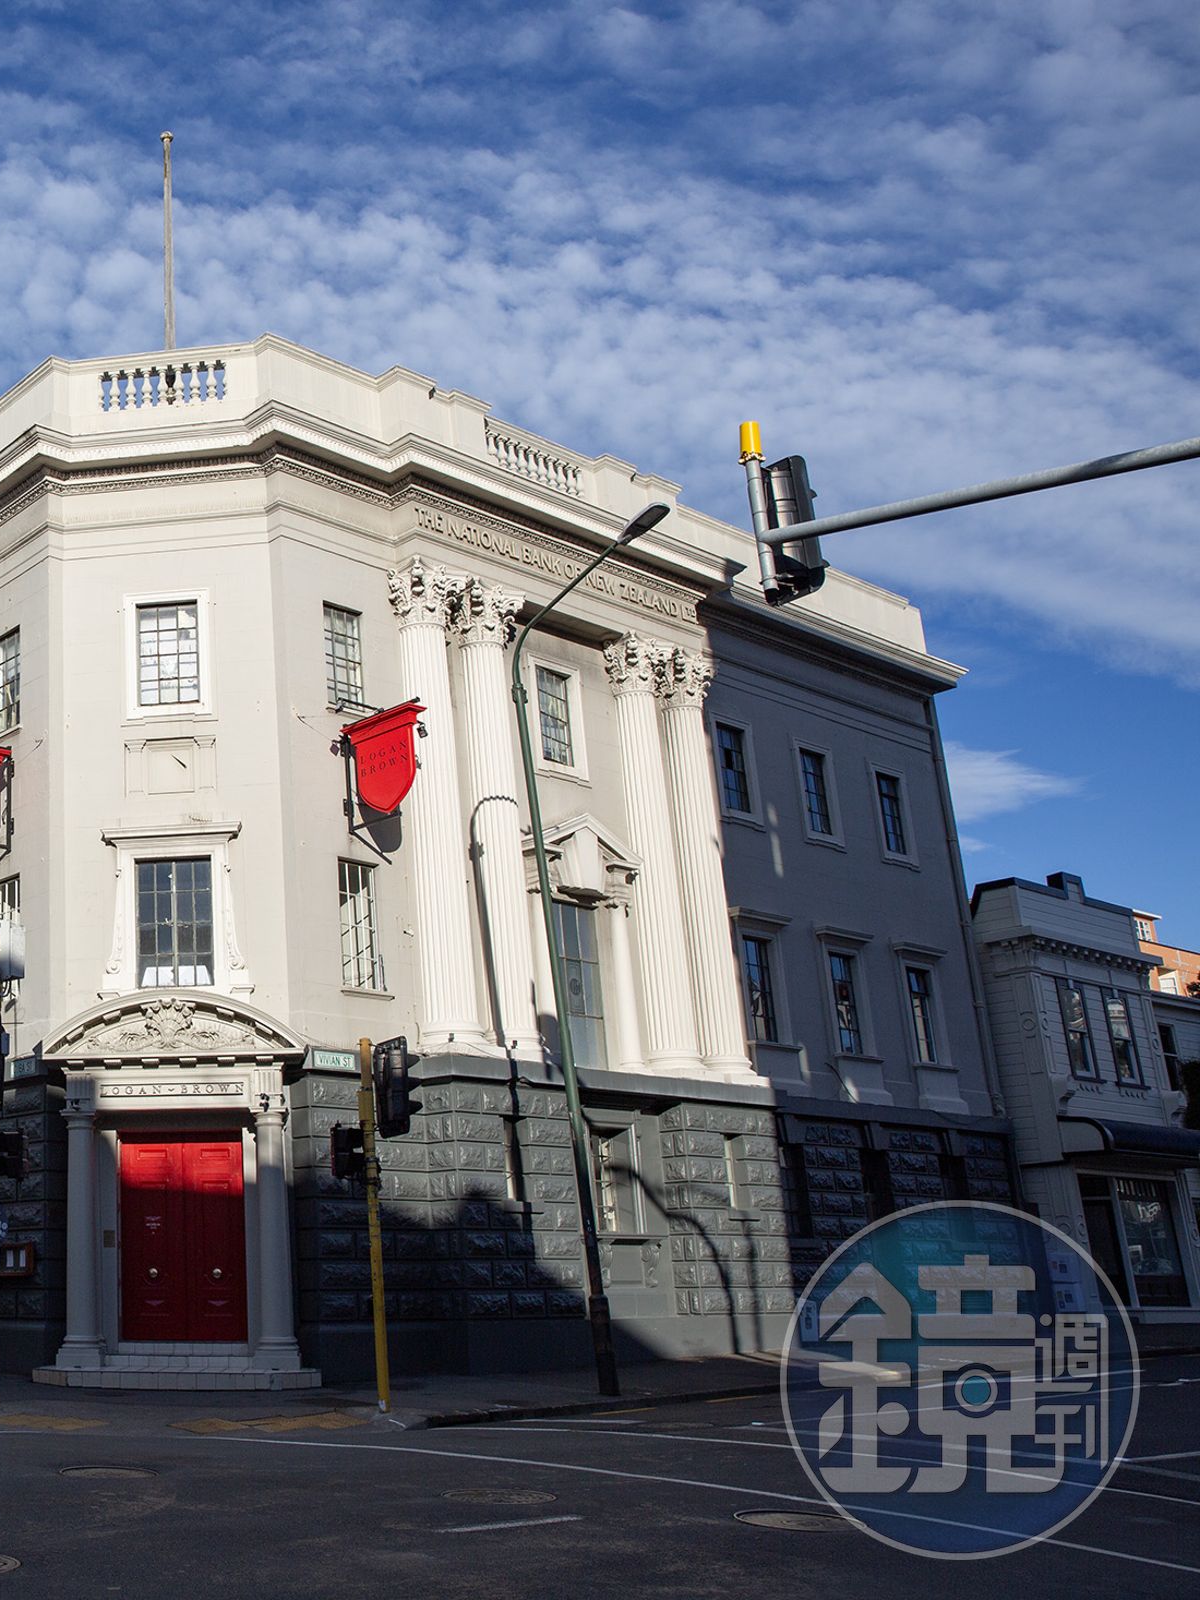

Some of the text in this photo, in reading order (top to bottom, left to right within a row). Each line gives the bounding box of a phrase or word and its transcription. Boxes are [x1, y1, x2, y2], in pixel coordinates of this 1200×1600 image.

[415, 508, 443, 533] THE
[448, 519, 519, 560] NATIONAL
[521, 546, 561, 576] BANK
[585, 573, 615, 596] NEW
[619, 583, 678, 617] ZEALAND
[361, 740, 406, 764] LOGAN
[361, 753, 407, 777] BROWN
[318, 1055, 352, 1067] VIVIAN ST
[100, 1084, 244, 1096] LOGAN BROWN
